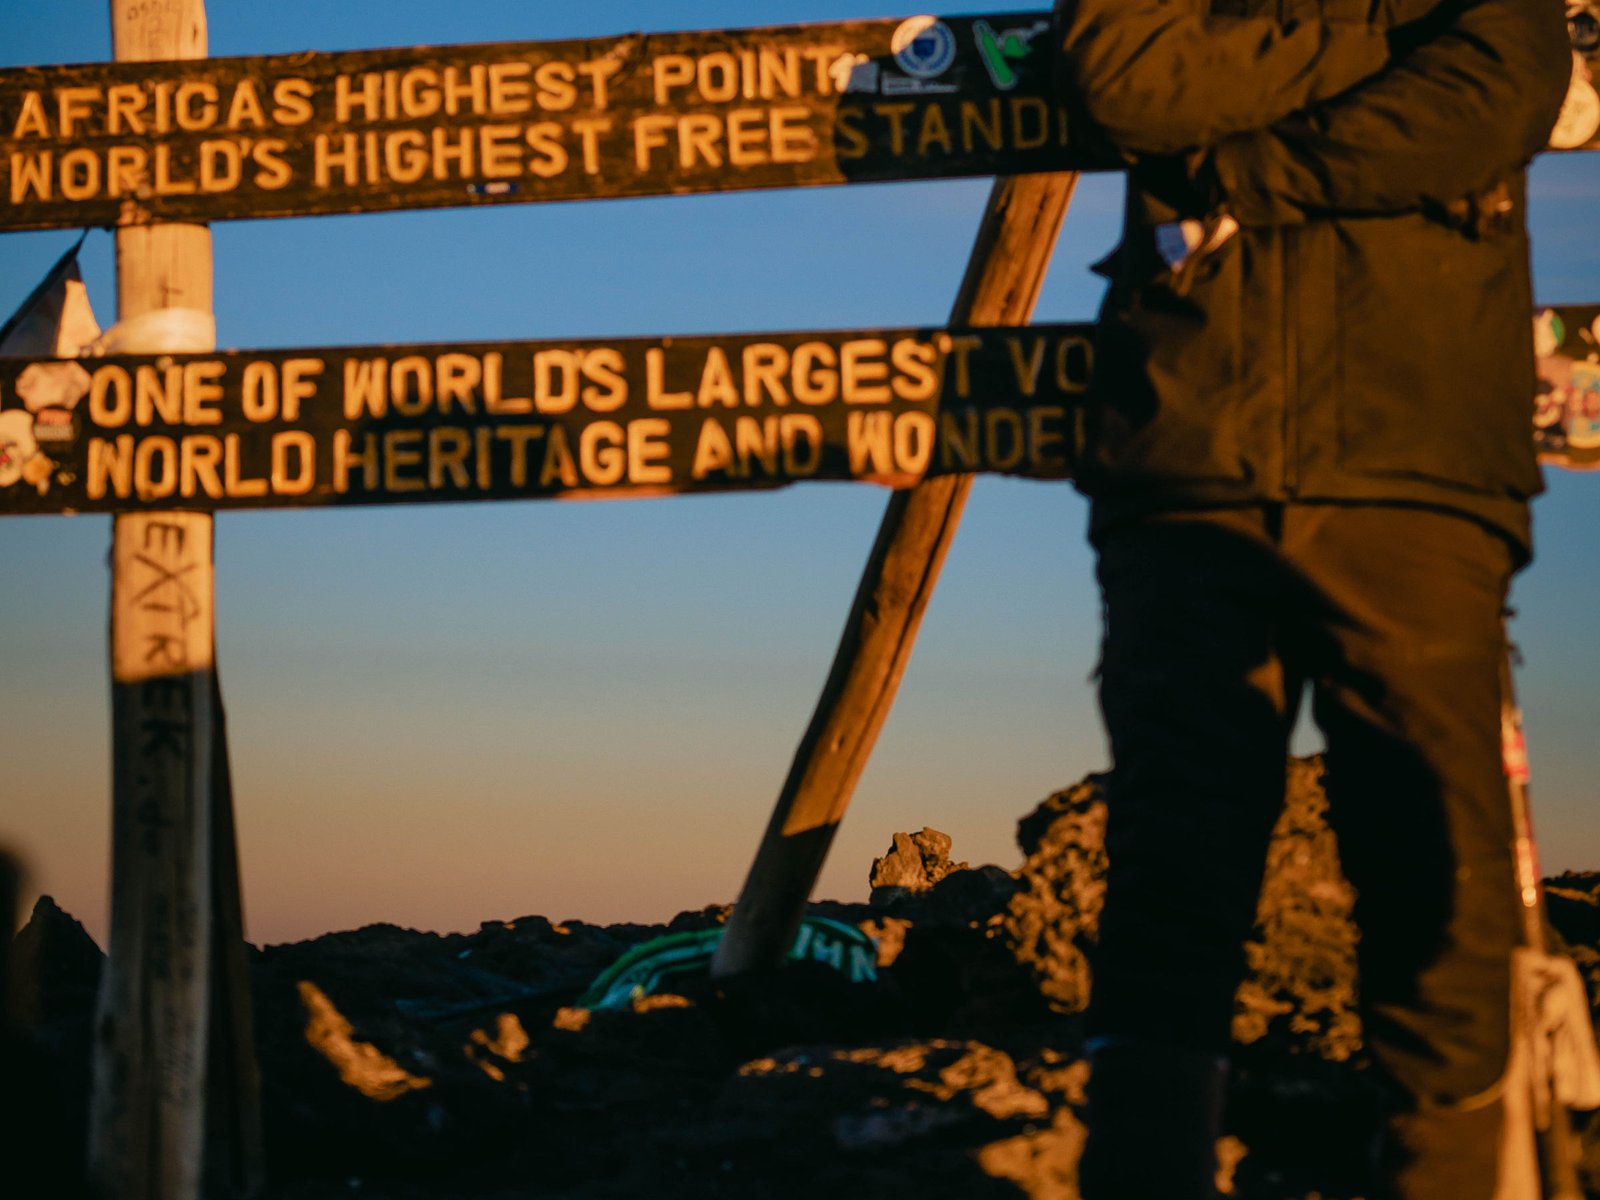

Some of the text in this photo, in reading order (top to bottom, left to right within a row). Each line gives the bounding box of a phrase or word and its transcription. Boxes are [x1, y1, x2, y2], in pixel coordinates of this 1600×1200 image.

[13, 46, 848, 140] AFRICAS HIGHEST POINT
[9, 96, 1069, 205] WORLD'S HIGHEST FREE STANDI
[87, 359, 227, 429] ONE
[242, 357, 325, 423] OF
[344, 346, 629, 420] WORLD'S
[645, 336, 981, 412] LARGEST
[1007, 336, 1096, 397] VO
[86, 404, 1086, 500] WORLD HERITAGE AND WONDE
